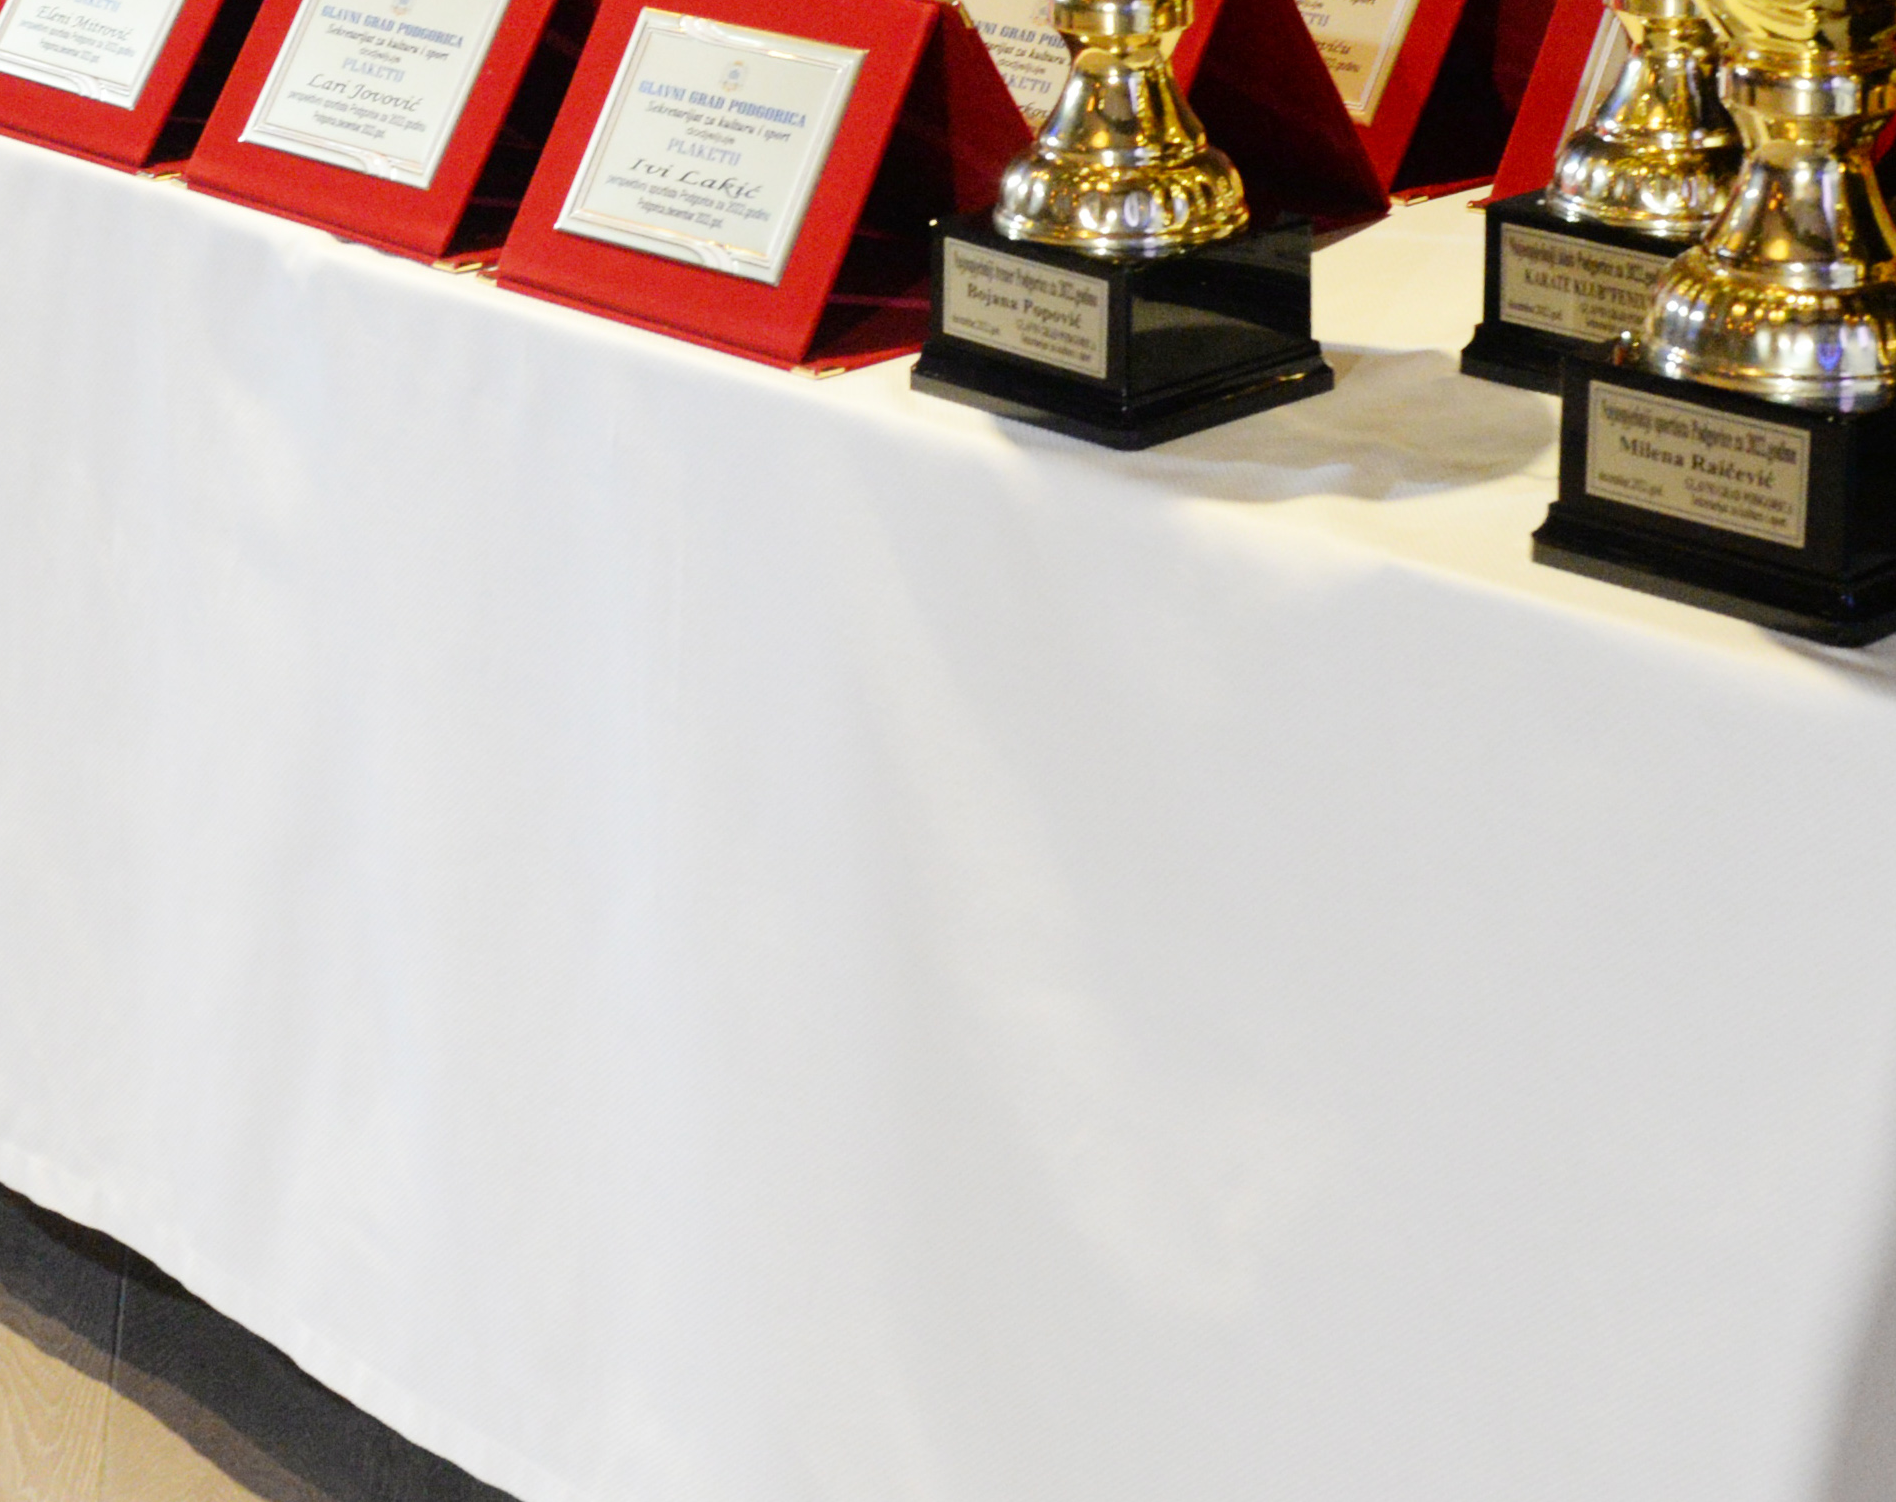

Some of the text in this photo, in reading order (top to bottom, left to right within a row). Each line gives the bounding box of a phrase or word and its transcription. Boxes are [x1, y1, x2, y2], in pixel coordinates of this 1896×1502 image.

[320, 4, 464, 48] GLAVNI GRAD PODGORICA
[997, 24, 1038, 43] GRAD
[306, 72, 423, 113] Lari Jovović
[637, 79, 806, 128] GLAVNI GRAD PODGORICA
[666, 137, 742, 167] PLAKETU
[629, 157, 763, 200] Ivi Lakić
[967, 281, 1017, 311] Bojana
[1023, 297, 1081, 330] Popović
[1619, 435, 1684, 467] Milena
[1691, 452, 1773, 489] Raičević
